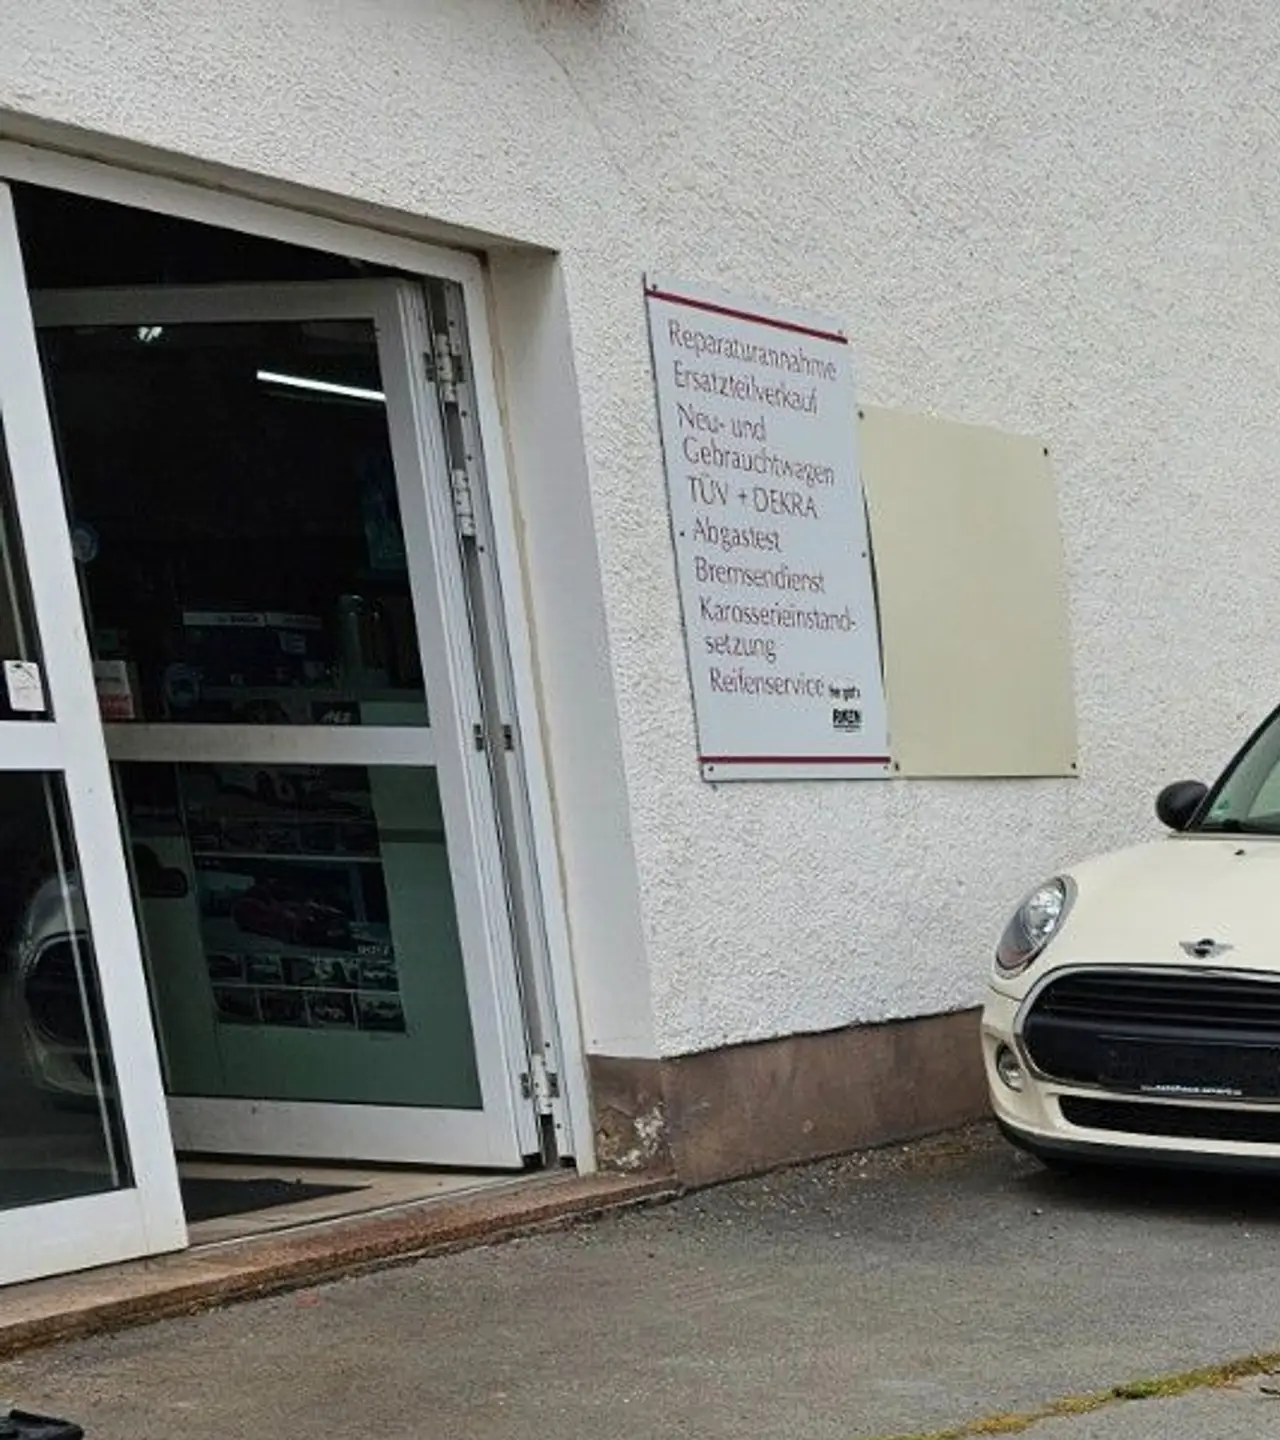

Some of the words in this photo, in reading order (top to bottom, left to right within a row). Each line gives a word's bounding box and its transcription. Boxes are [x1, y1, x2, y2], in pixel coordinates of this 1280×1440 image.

[668, 319, 837, 381] Reparaturannahme
[673, 360, 818, 414] Ersatzteilverkauf
[676, 402, 725, 433] Neu-
[731, 416, 767, 441] und
[683, 436, 834, 487] Gebrauchtwagen
[687, 472, 728, 505] TÜV
[738, 489, 748, 504] +
[752, 487, 818, 519] DEKRA
[694, 516, 783, 552] Abgastest
[694, 555, 826, 593] Bremsendienst
[699, 595, 857, 631] Karosserieinstand-
[705, 634, 777, 663] setzung
[709, 667, 825, 698] Reifenservice
